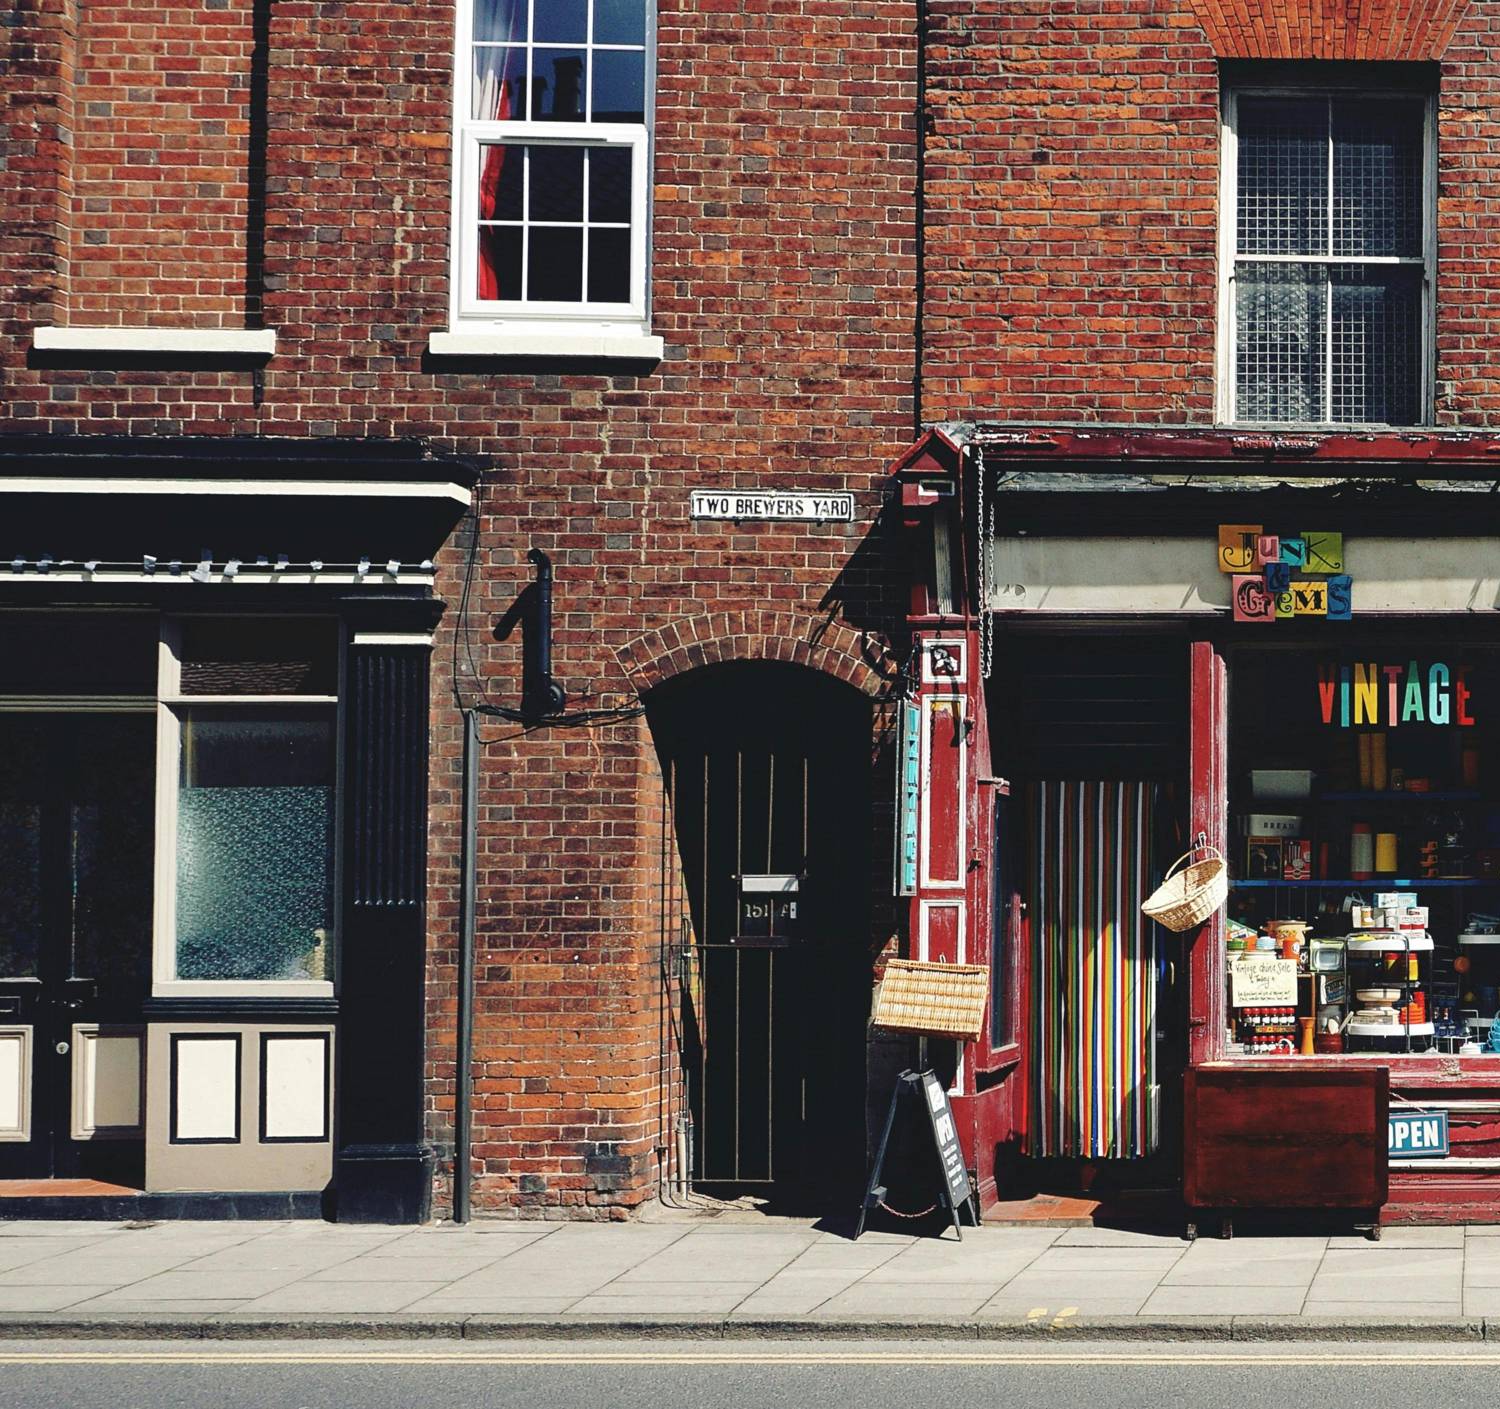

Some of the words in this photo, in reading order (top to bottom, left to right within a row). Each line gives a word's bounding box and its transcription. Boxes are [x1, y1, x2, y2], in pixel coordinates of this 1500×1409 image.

[696, 498, 729, 514] TWO
[736, 499, 804, 516] BREWERS
[813, 500, 849, 516] YARD
[1317, 660, 1475, 727] VINTAGE
